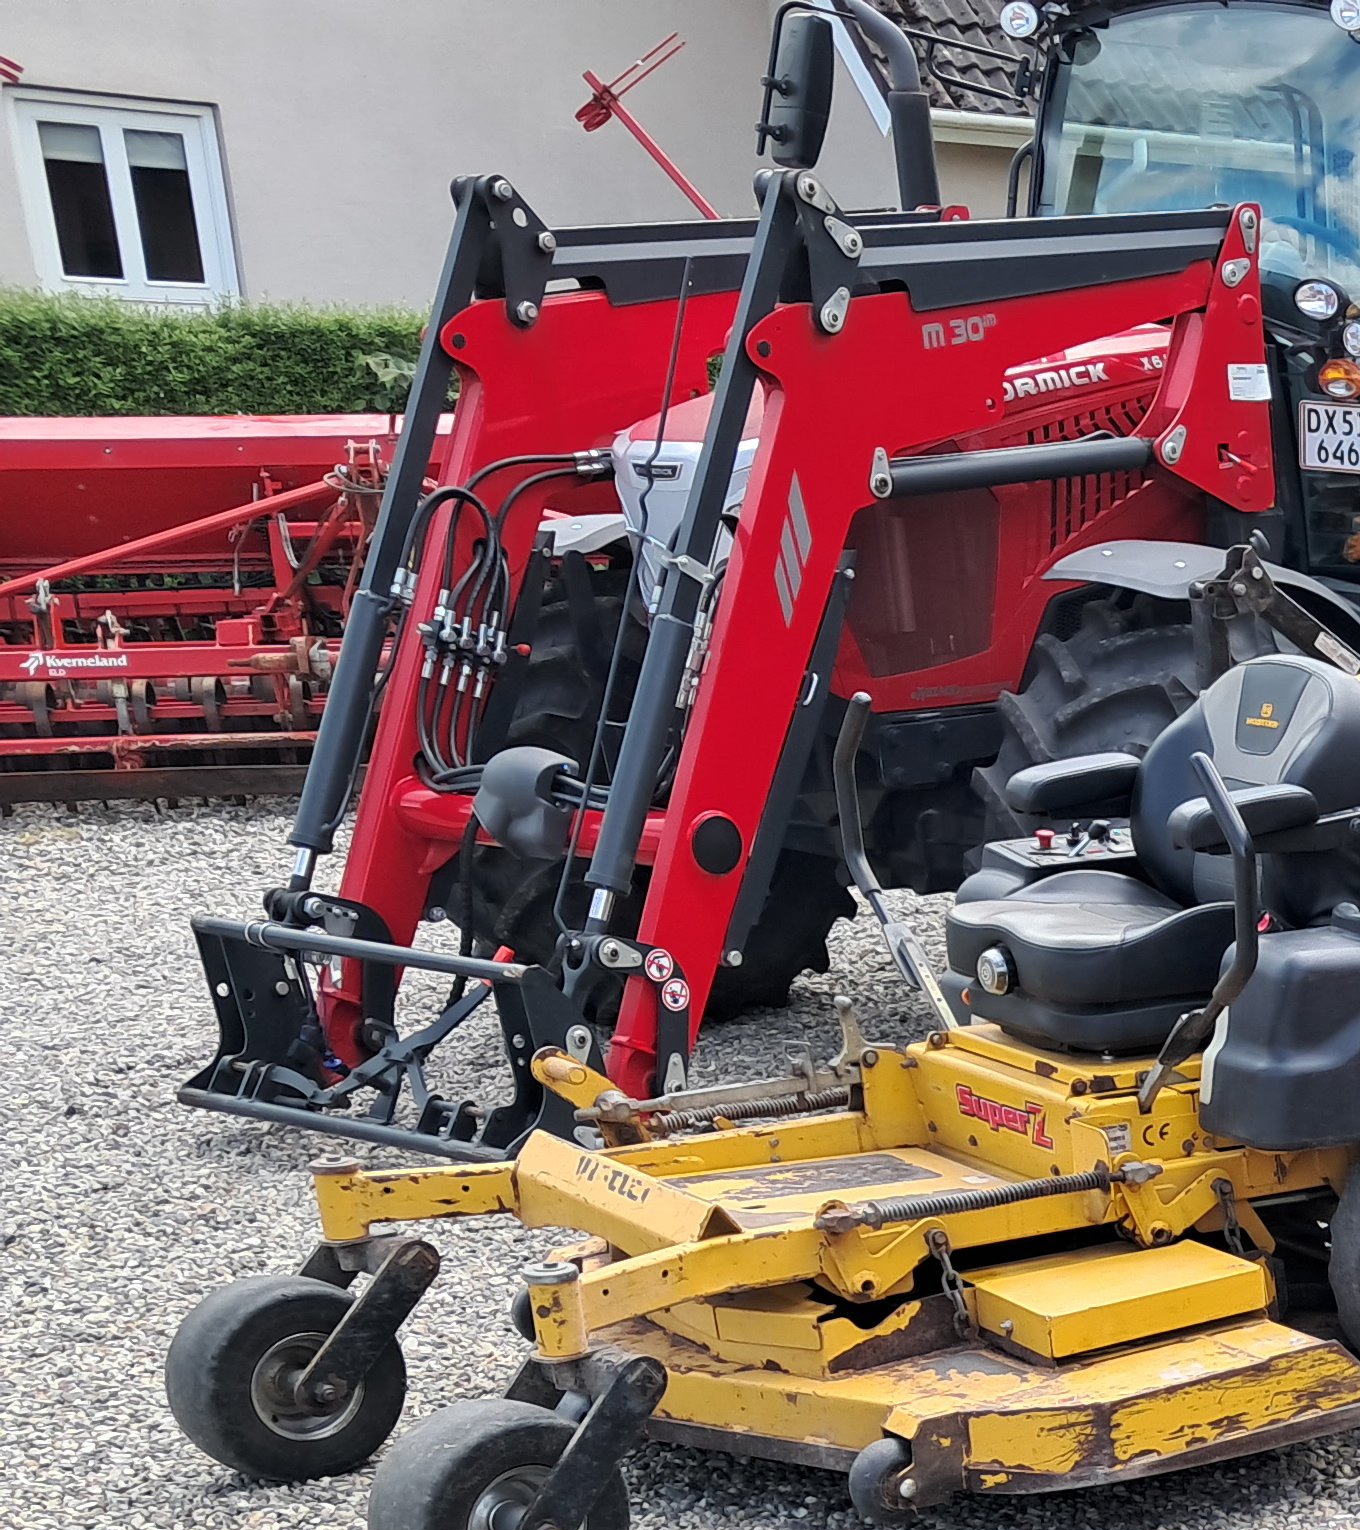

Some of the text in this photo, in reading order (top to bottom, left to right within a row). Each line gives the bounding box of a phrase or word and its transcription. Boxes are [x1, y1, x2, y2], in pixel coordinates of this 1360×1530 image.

[922, 322, 946, 350] M
[1317, 438, 1360, 467] 646
[45, 654, 128, 668] Kverneland
